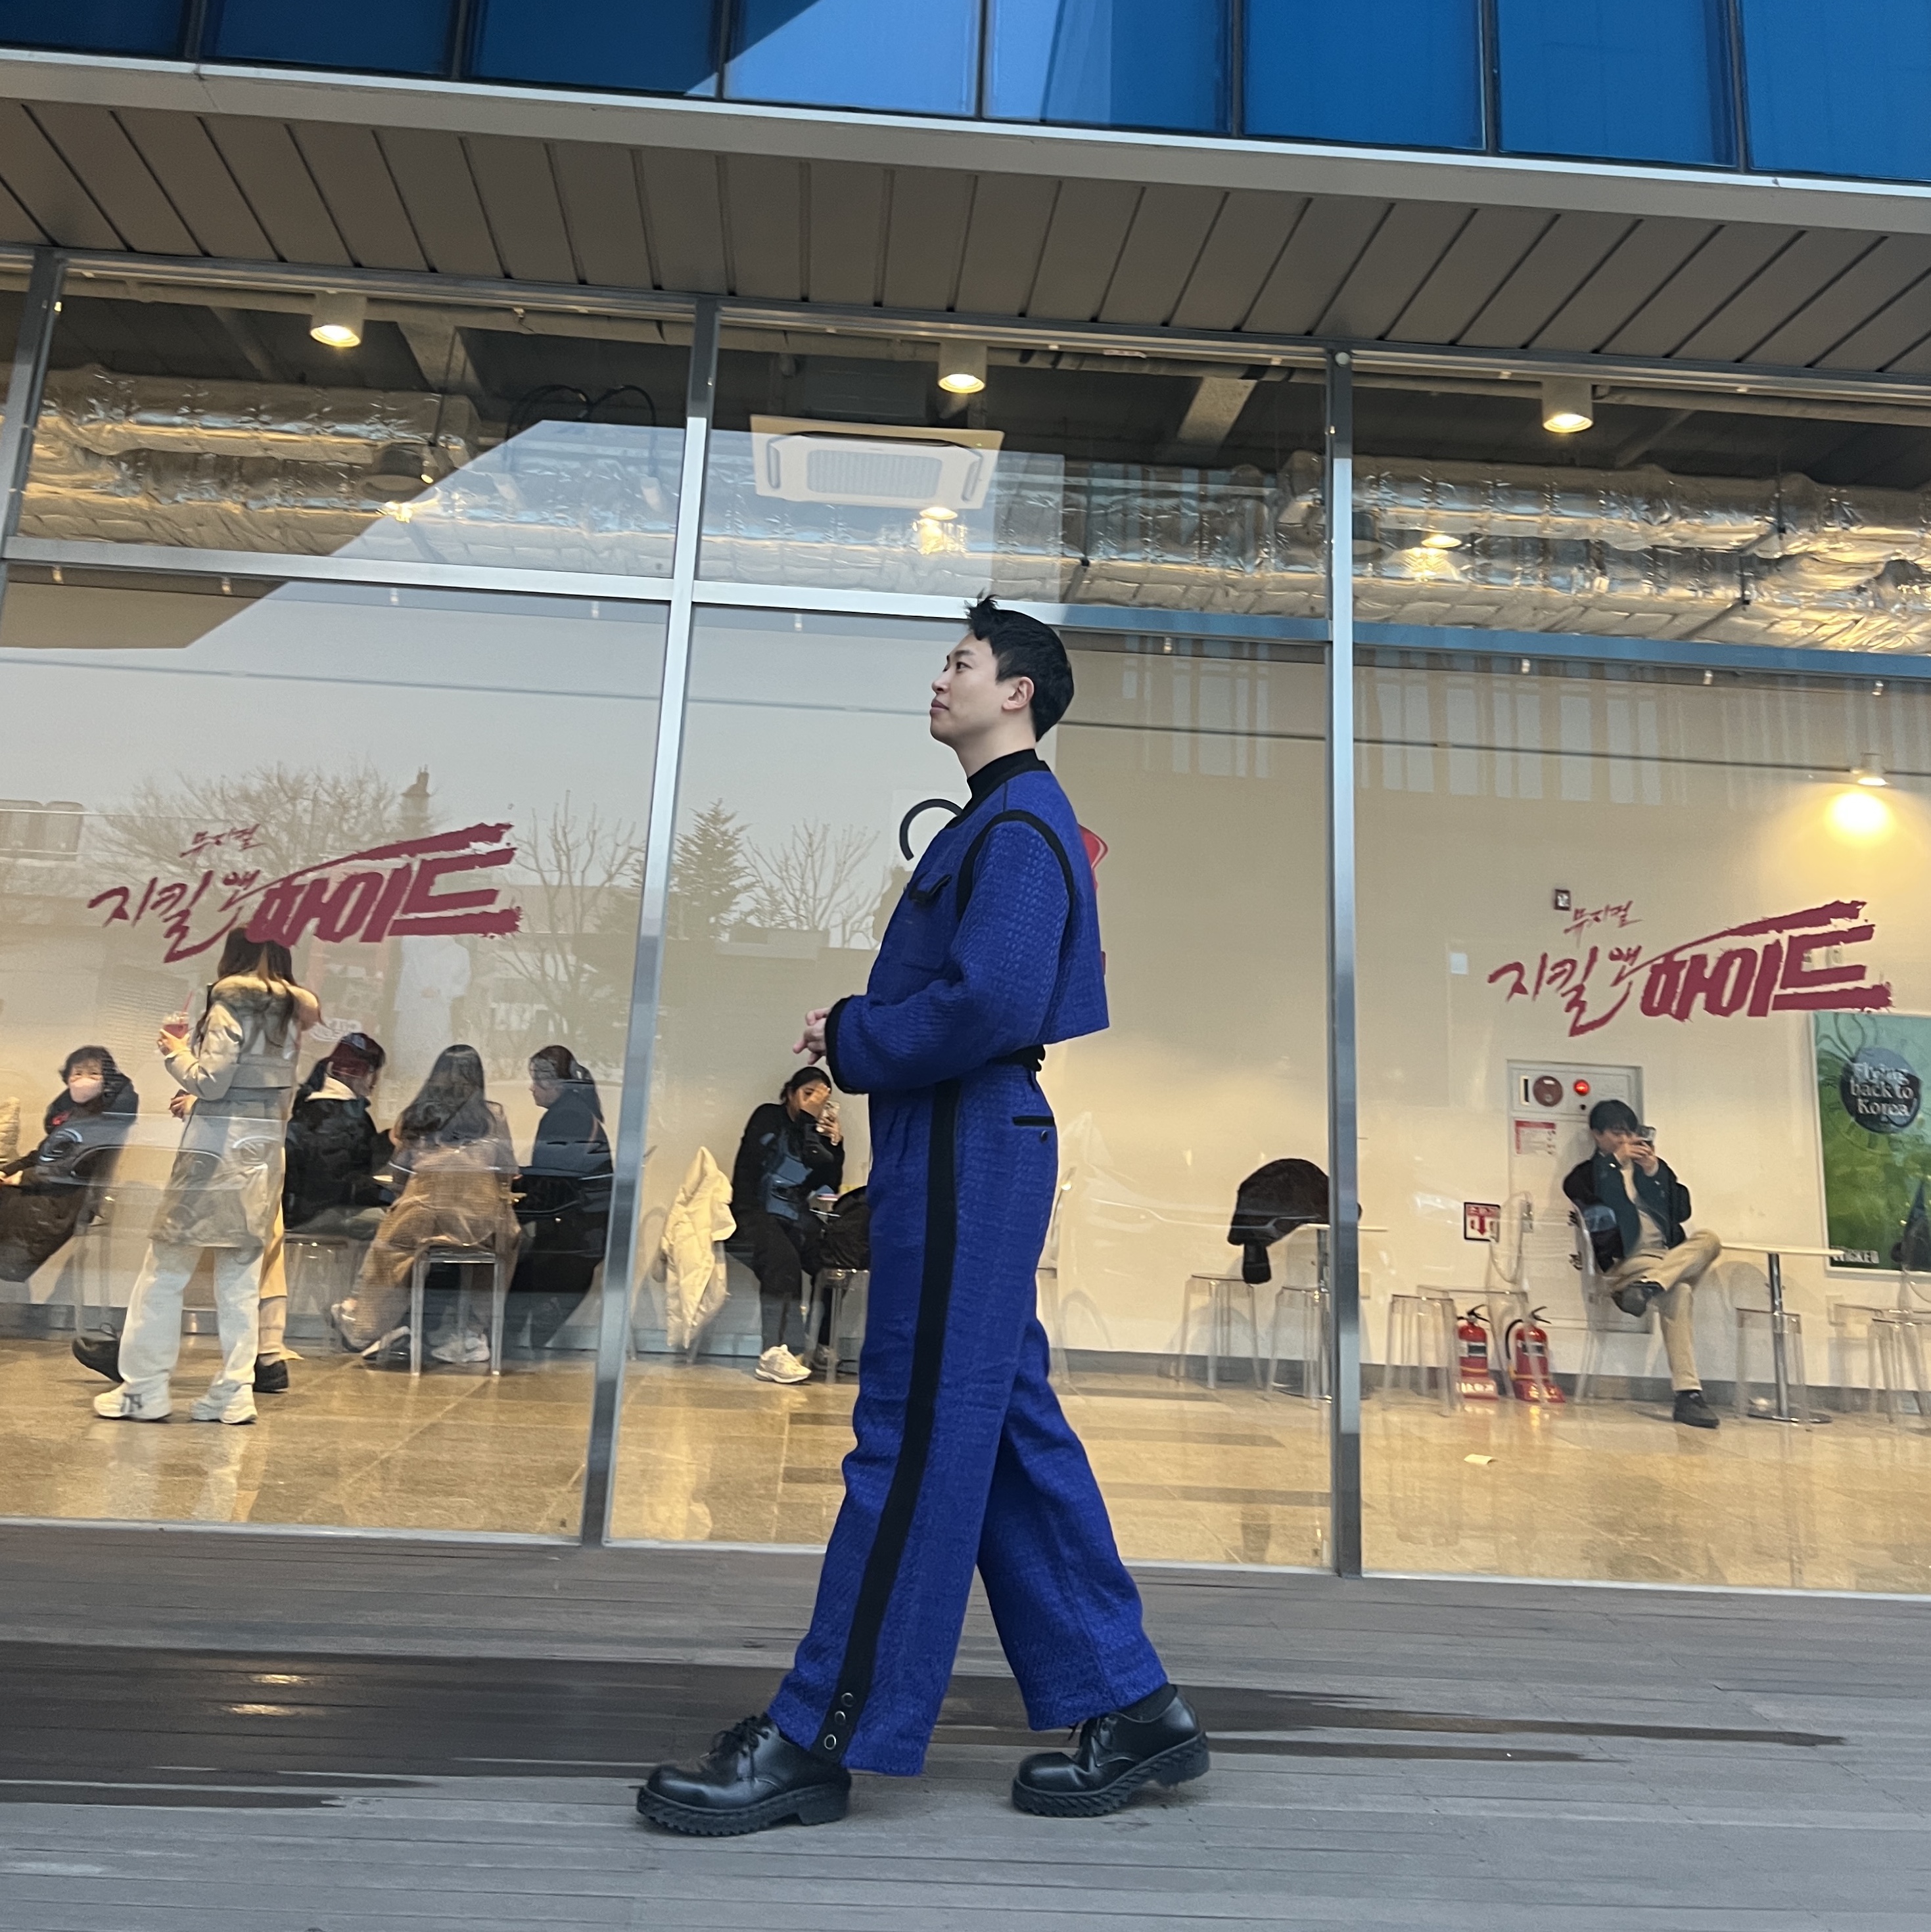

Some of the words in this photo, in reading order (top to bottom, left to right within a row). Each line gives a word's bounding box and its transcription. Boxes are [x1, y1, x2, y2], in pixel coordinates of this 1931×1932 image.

[244, 822, 523, 948] 하이드
[1639, 900, 1893, 1023] 하이드
[1850, 1078, 1893, 1098] back
[1894, 1084, 1915, 1099] to
